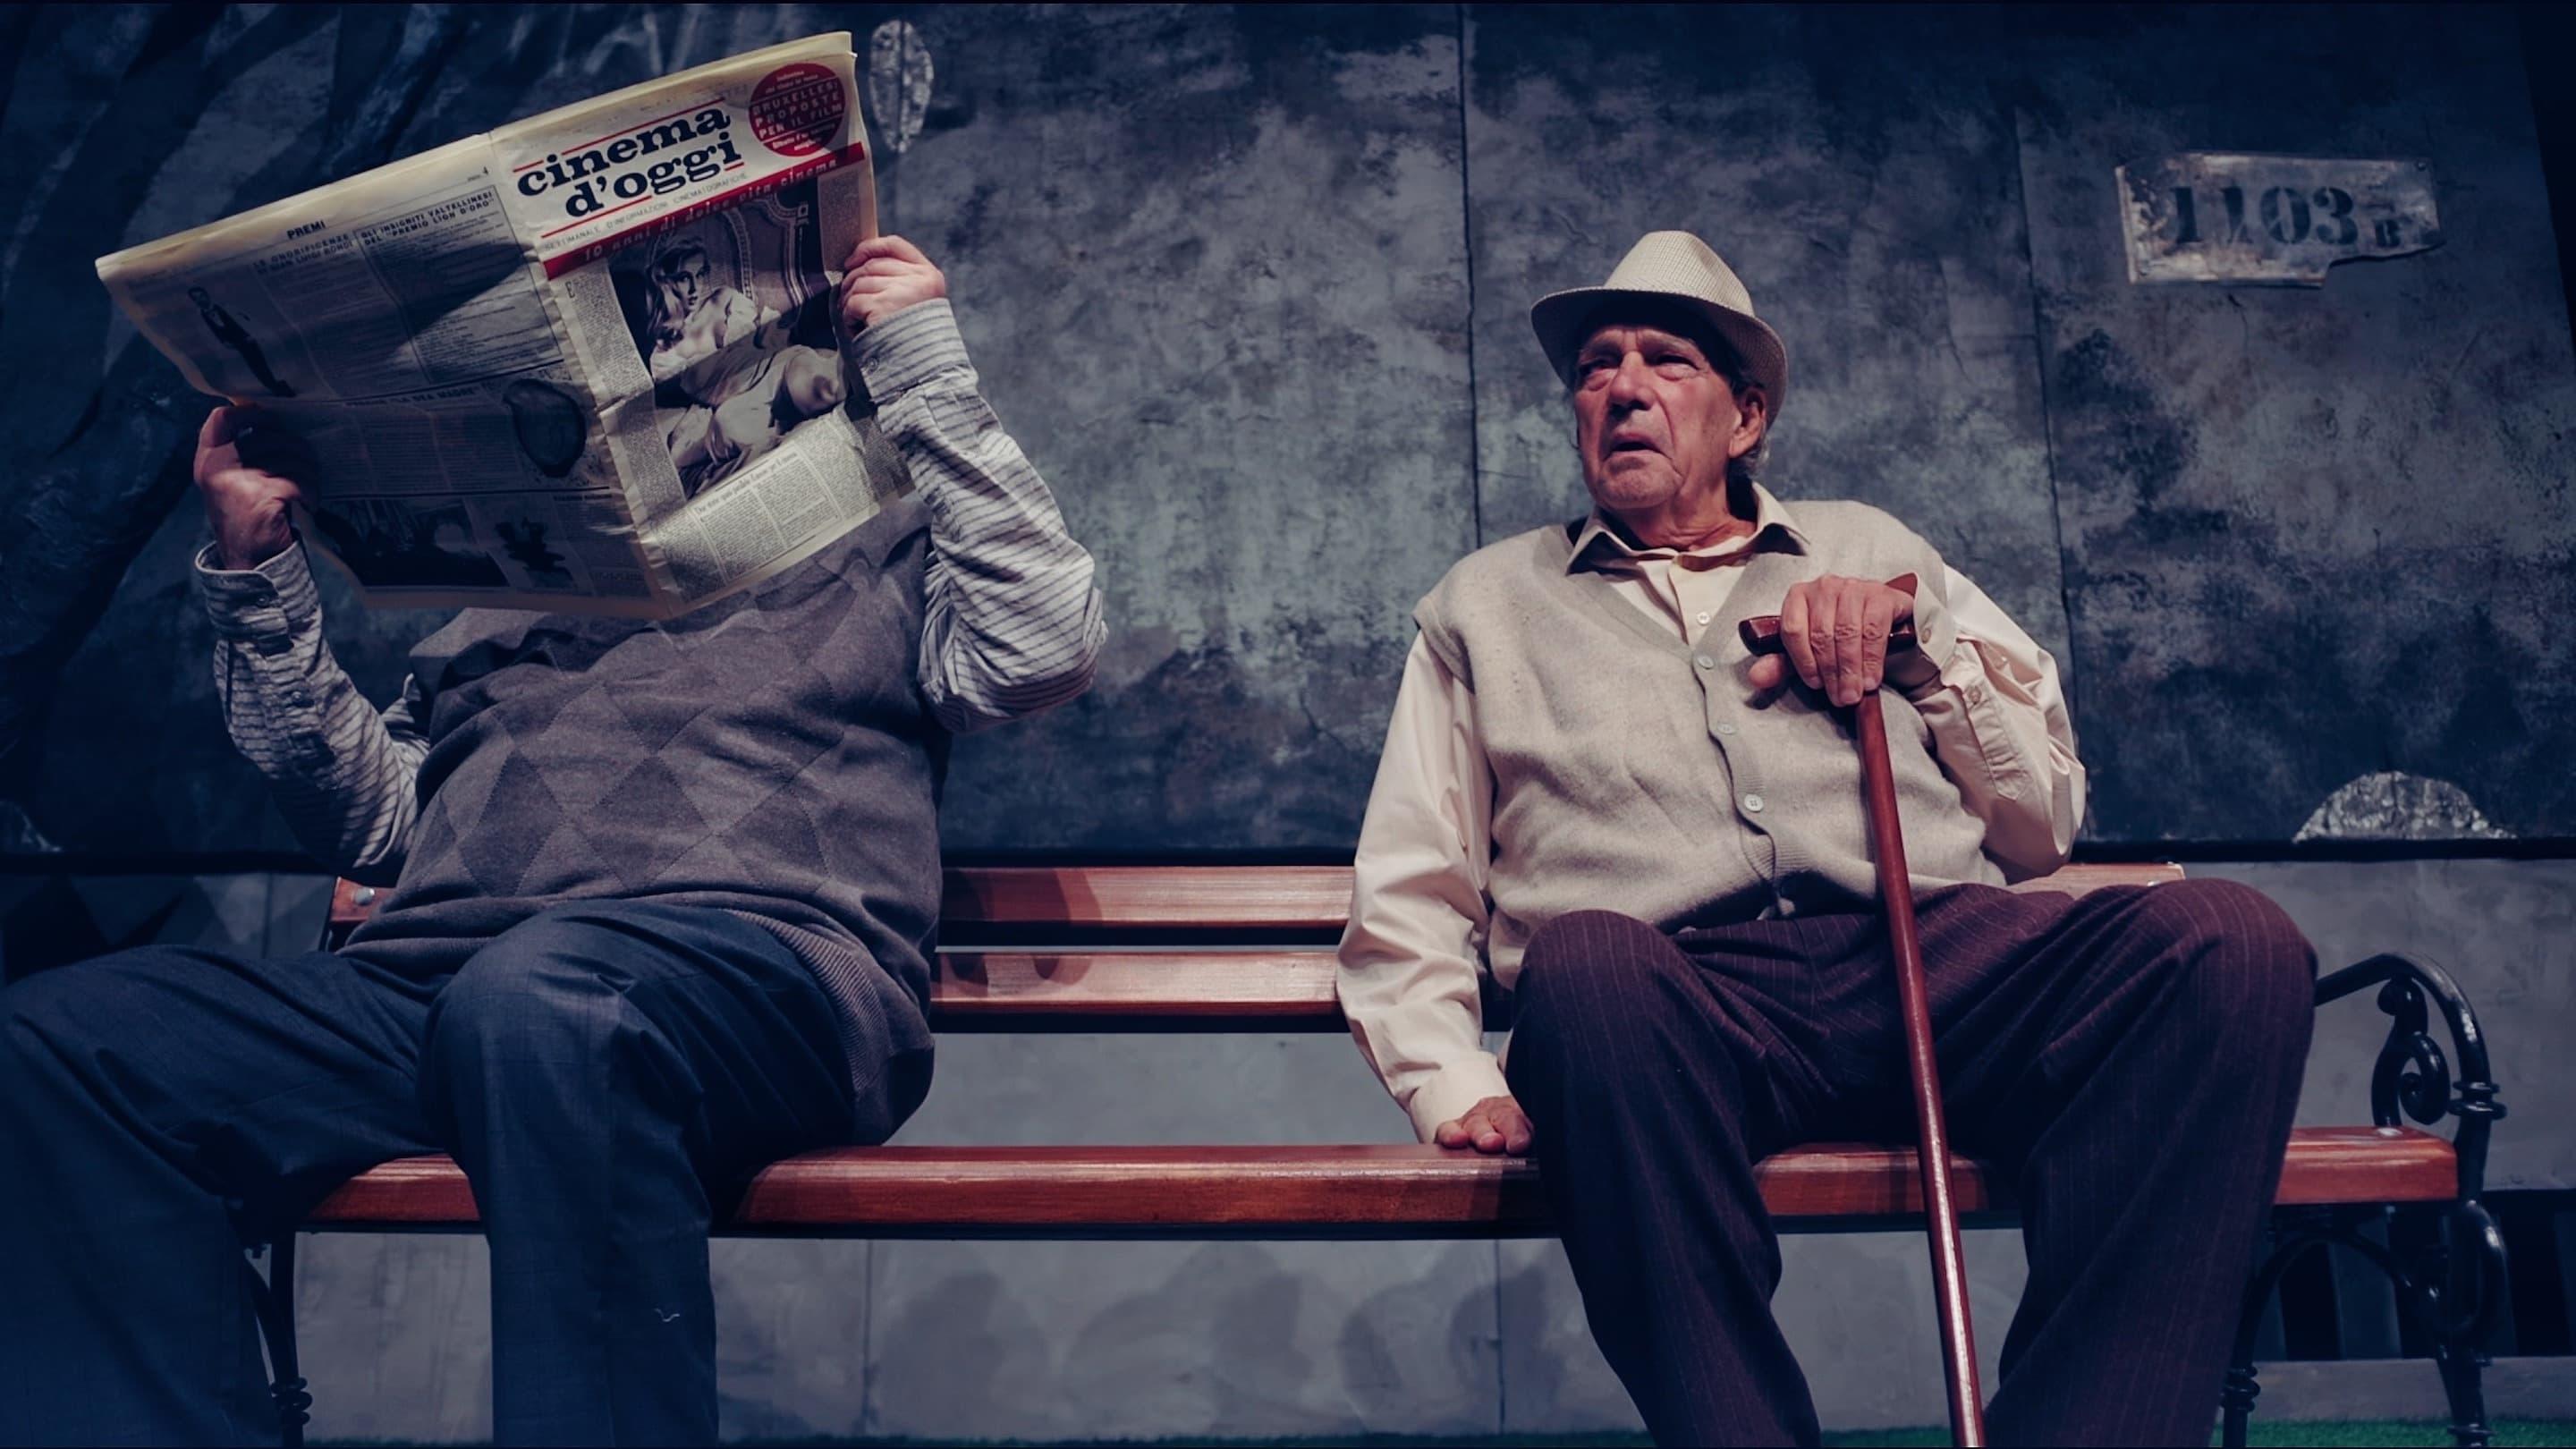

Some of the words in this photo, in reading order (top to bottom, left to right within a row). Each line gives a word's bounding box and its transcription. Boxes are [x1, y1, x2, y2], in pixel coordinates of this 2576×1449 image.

[755, 91, 839, 128] PROPOSTE
[758, 123, 785, 140] PER
[791, 115, 805, 128] IL
[810, 103, 843, 121] FILM
[517, 107, 731, 197] cinema
[565, 131, 741, 217] d'oggi
[428, 191, 494, 218] VALTELLINESI
[613, 225, 651, 250] anni
[660, 216, 675, 232] di
[739, 182, 773, 203] vita
[780, 157, 837, 187] cinema
[2170, 186, 2359, 247] 1103
[286, 219, 326, 241] PREMI
[365, 234, 382, 246] DEL
[433, 211, 456, 225] LION
